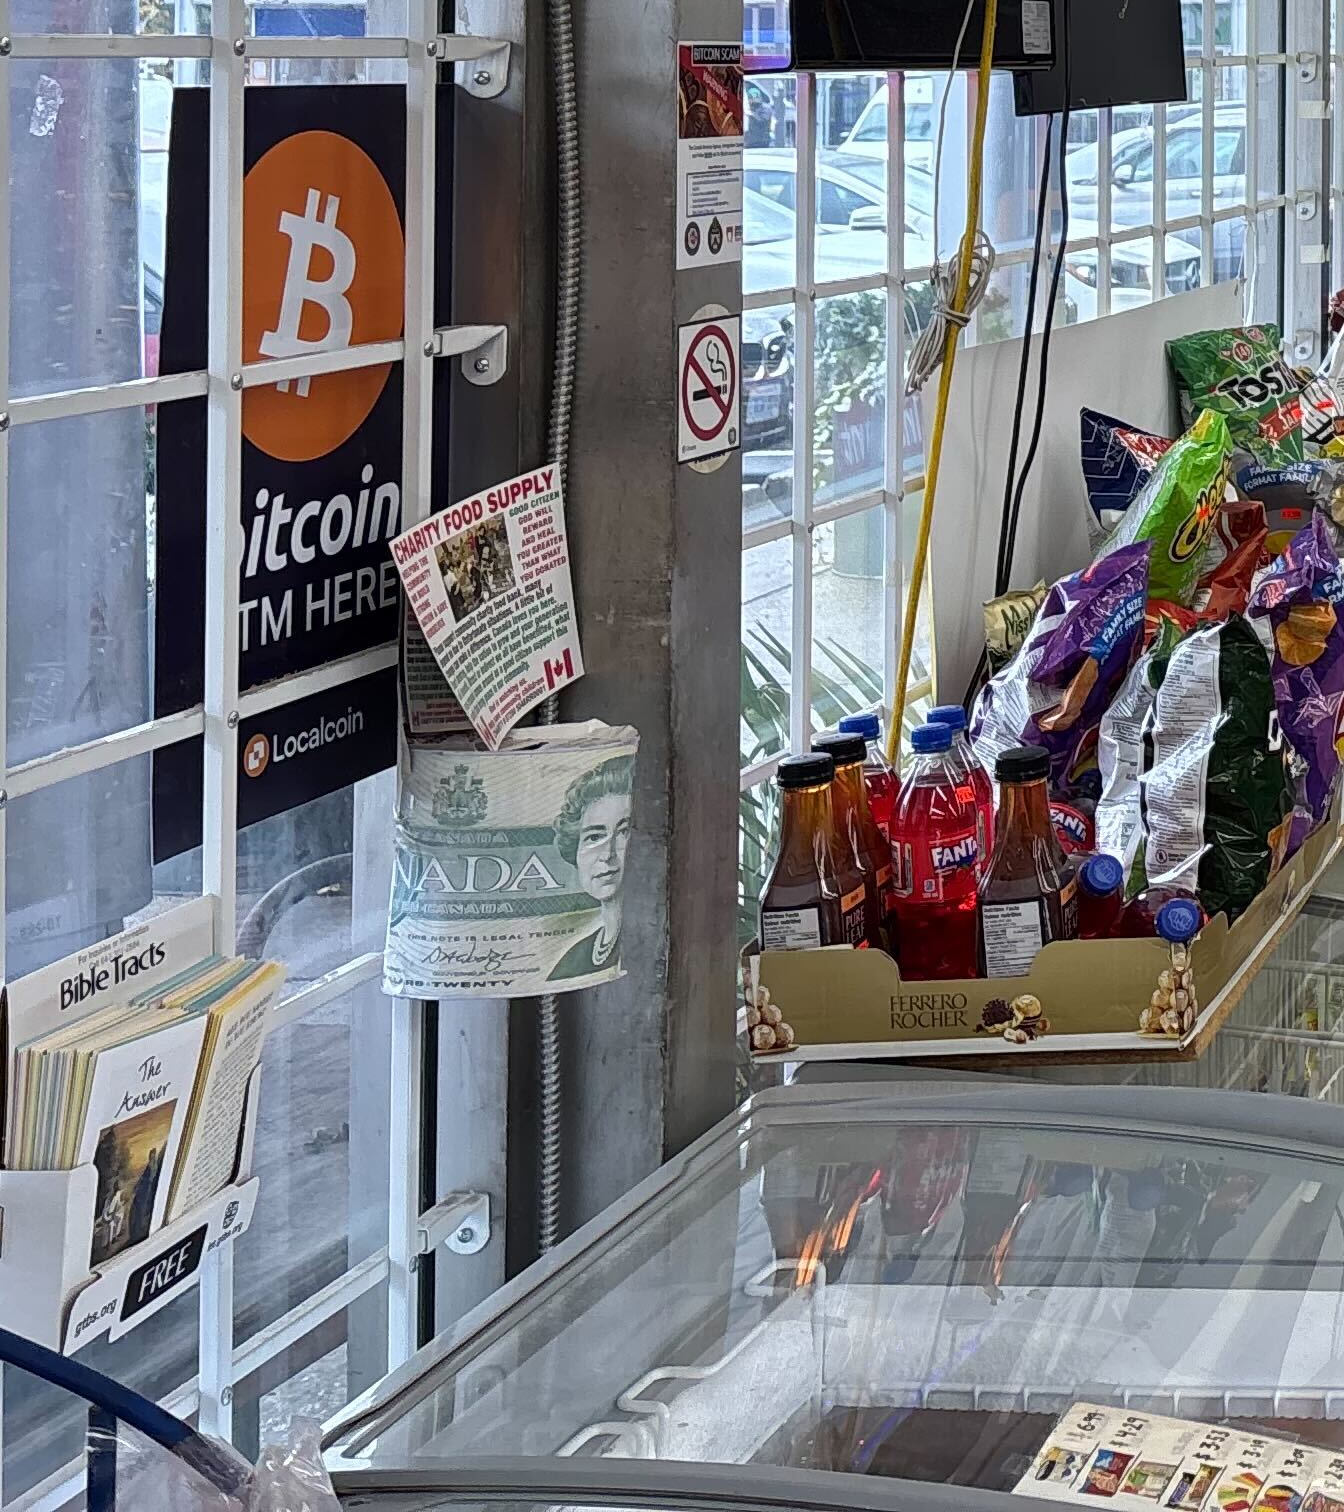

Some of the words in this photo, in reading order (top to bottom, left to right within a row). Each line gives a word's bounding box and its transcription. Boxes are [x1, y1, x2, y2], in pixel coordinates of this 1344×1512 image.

[693, 46, 721, 61] BITCOIN
[721, 47, 740, 61] SCAM
[393, 519, 441, 564] CHARITY
[443, 499, 483, 536] FOOD
[486, 469, 553, 514] SUPPLY
[509, 505, 529, 518] GOOD
[530, 490, 560, 508] CITIZEN
[518, 513, 533, 525] GOD
[535, 505, 553, 518] WILL
[240, 463, 400, 578] itcoin
[522, 516, 553, 535] REWARD
[517, 548, 530, 561] YOU
[531, 534, 564, 555] GREATER
[521, 535, 535, 547] AND
[537, 526, 556, 542] HEAL
[520, 570, 533, 583] YOU
[535, 555, 567, 576] DONATED
[522, 556, 540, 570] THAN
[541, 546, 562, 561] WHAT
[305, 559, 397, 632] HERE
[1101, 608, 1126, 641] FAMILY
[1125, 596, 1143, 615] SIZE
[272, 706, 364, 763] Localcoin
[931, 837, 977, 869] FANTA
[423, 903, 514, 914] CANADA
[845, 907, 865, 929] PURE
[482, 934, 524, 942] LEGAL
[528, 927, 575, 938] TENDER
[60, 966, 110, 1011] Bible
[111, 941, 165, 985] Tracts
[432, 980, 514, 988] TWENTY
[890, 993, 967, 1010] FERRERO
[890, 1010, 968, 1029] ROCHER
[138, 1056, 162, 1082] The
[115, 1082, 171, 1118] Answer
[137, 1241, 192, 1303] FREE
[74, 1299, 117, 1338] gtbs.org
